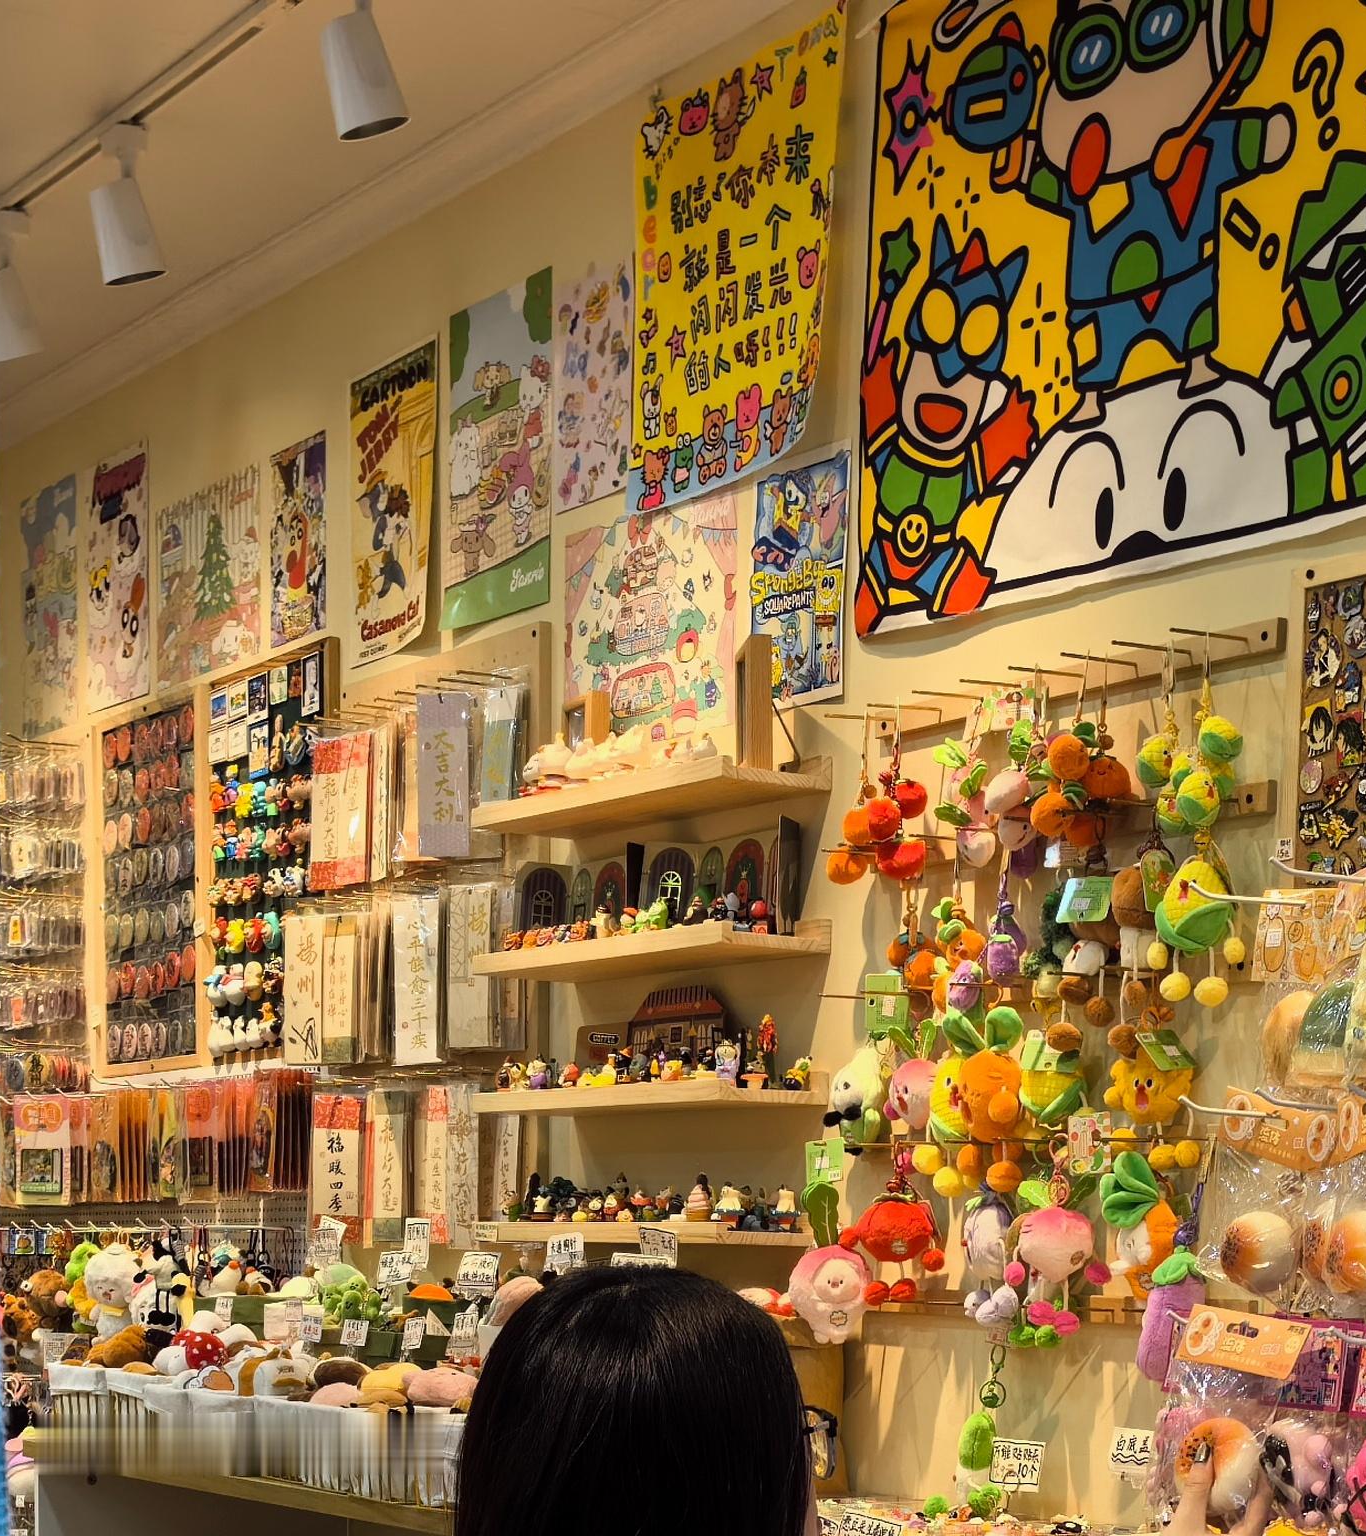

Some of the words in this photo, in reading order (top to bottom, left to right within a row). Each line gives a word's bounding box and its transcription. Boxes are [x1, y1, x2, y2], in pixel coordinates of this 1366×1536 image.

[671, 124, 814, 234] 别忘了你本来
[679, 204, 792, 293] 就是一个
[691, 258, 792, 345] 闪闪发光
[360, 359, 429, 412] CARTOON
[763, 590, 815, 616] SQUAREPANTS
[327, 1131, 346, 1213] 福暖四季
